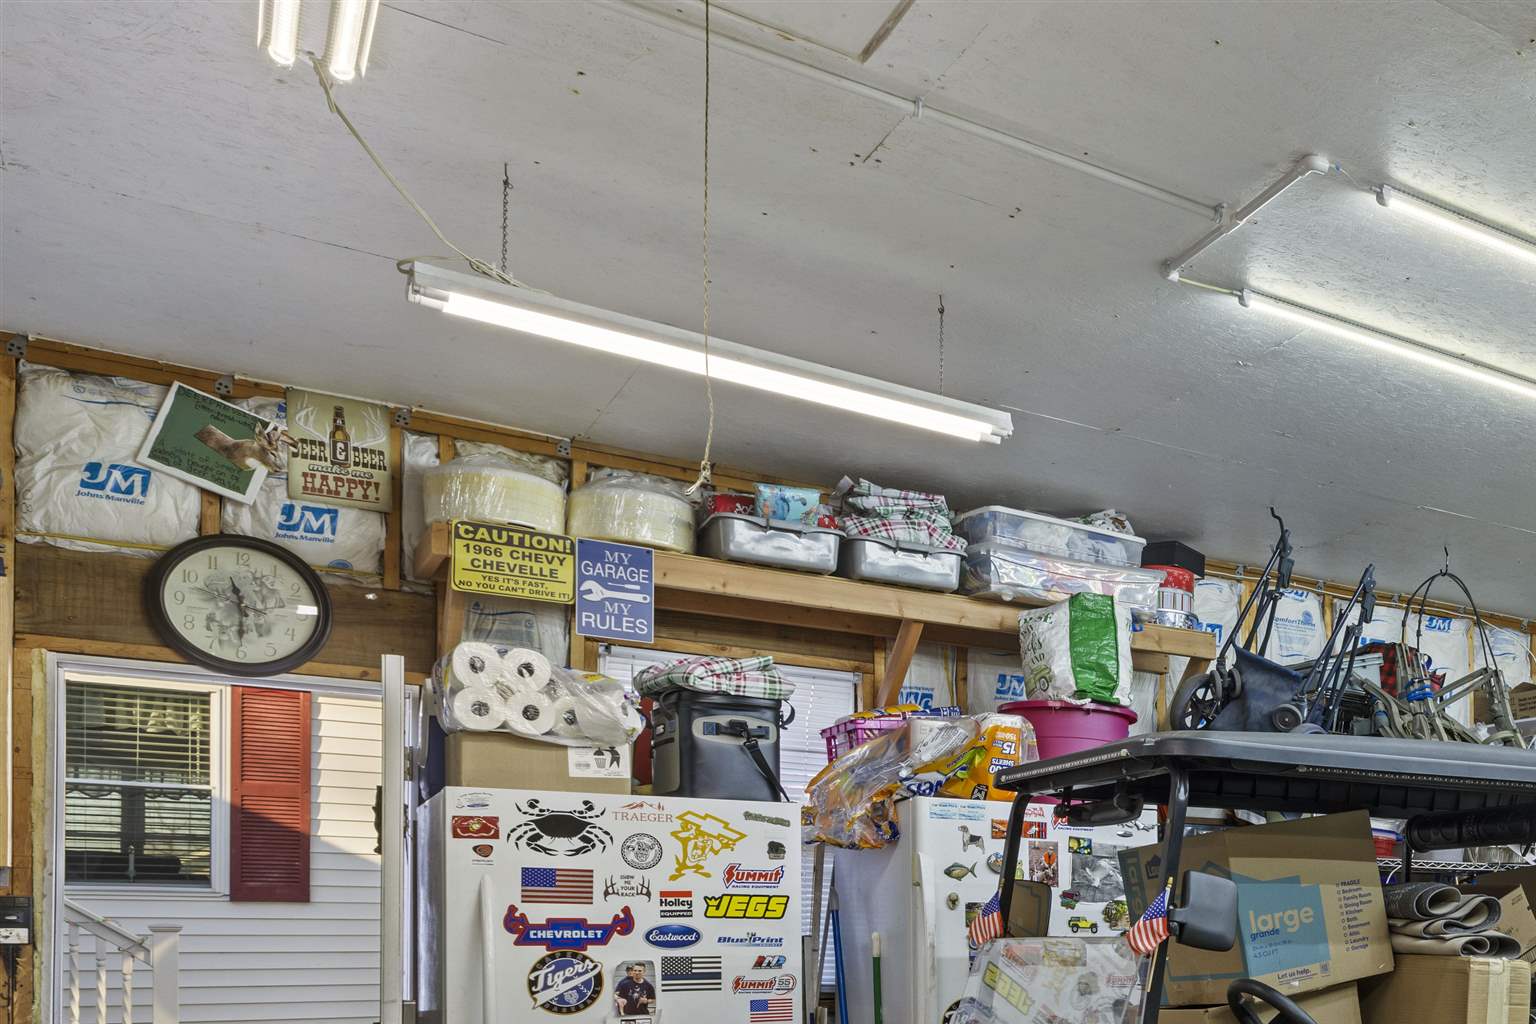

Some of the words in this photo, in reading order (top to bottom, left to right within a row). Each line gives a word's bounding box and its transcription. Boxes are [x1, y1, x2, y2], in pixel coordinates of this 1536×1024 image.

[336, 442, 346, 460] &
[352, 446, 387, 471] BEER
[80, 461, 151, 497] JM
[308, 464, 349, 476] make
[351, 470, 374, 479] me
[302, 471, 380, 501] HAPPY!
[75, 490, 104, 498] Johns
[105, 494, 145, 505] Manville
[277, 502, 338, 536] JM
[275, 532, 298, 540] Johns
[300, 534, 335, 544] Manville
[459, 525, 571, 554] CAUTION!
[236, 552, 249, 567] 12
[463, 543, 503, 558] 1966
[509, 550, 566, 566] CHEVY
[604, 550, 632, 565] MY
[208, 555, 218, 570] 11
[471, 558, 558, 579] CHEVELLE
[182, 569, 198, 583] 10
[481, 574, 500, 583] YES
[502, 576, 520, 585] IT'S
[581, 560, 649, 584] GARAGE
[290, 583, 301, 597] 2
[476, 581, 495, 590] YOU
[498, 585, 526, 593] CAN'T
[528, 588, 556, 598] DRIVE
[559, 592, 570, 600] IT!
[174, 591, 185, 605] 9
[604, 601, 632, 616] MY
[184, 615, 195, 630] 8
[582, 612, 648, 634] RULES
[1425, 617, 1452, 633] JM
[285, 628, 296, 641] 4
[236, 646, 247, 659] 6
[264, 642, 277, 657] 5
[1002, 742, 1016, 755] 15
[612, 811, 673, 823] TRAEGER
[660, 899, 693, 909] Holley
[704, 894, 790, 919] JEGS
[1249, 906, 1313, 933] large
[529, 930, 603, 939] CHEVROLET
[650, 928, 697, 941] Eastwood
[1250, 928, 1280, 942] grande
[529, 959, 594, 992] Tigers
[1296, 968, 1311, 976] help.
[778, 978, 791, 986] 55
